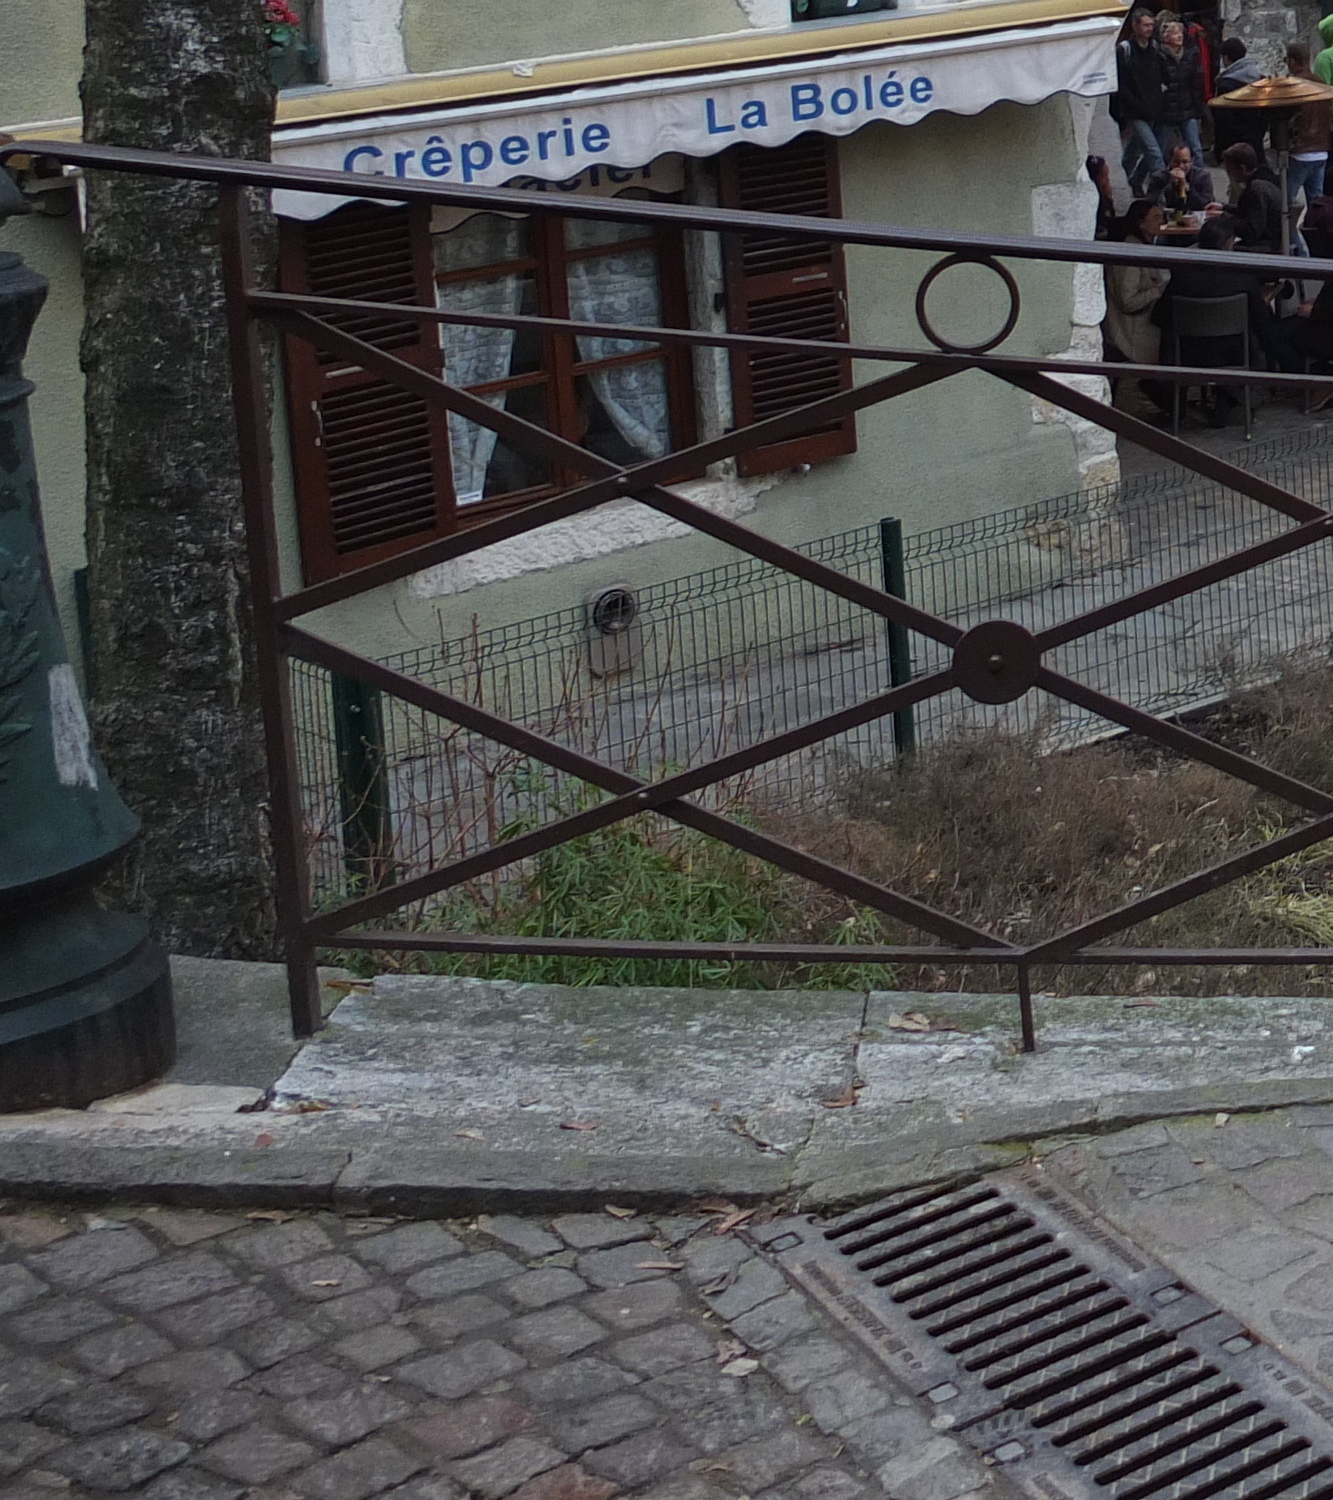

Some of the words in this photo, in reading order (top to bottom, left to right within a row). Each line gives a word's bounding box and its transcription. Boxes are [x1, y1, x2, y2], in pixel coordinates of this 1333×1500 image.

[343, 117, 612, 184] Crêperie
[706, 97, 768, 135] La
[791, 70, 934, 122] Bolée
